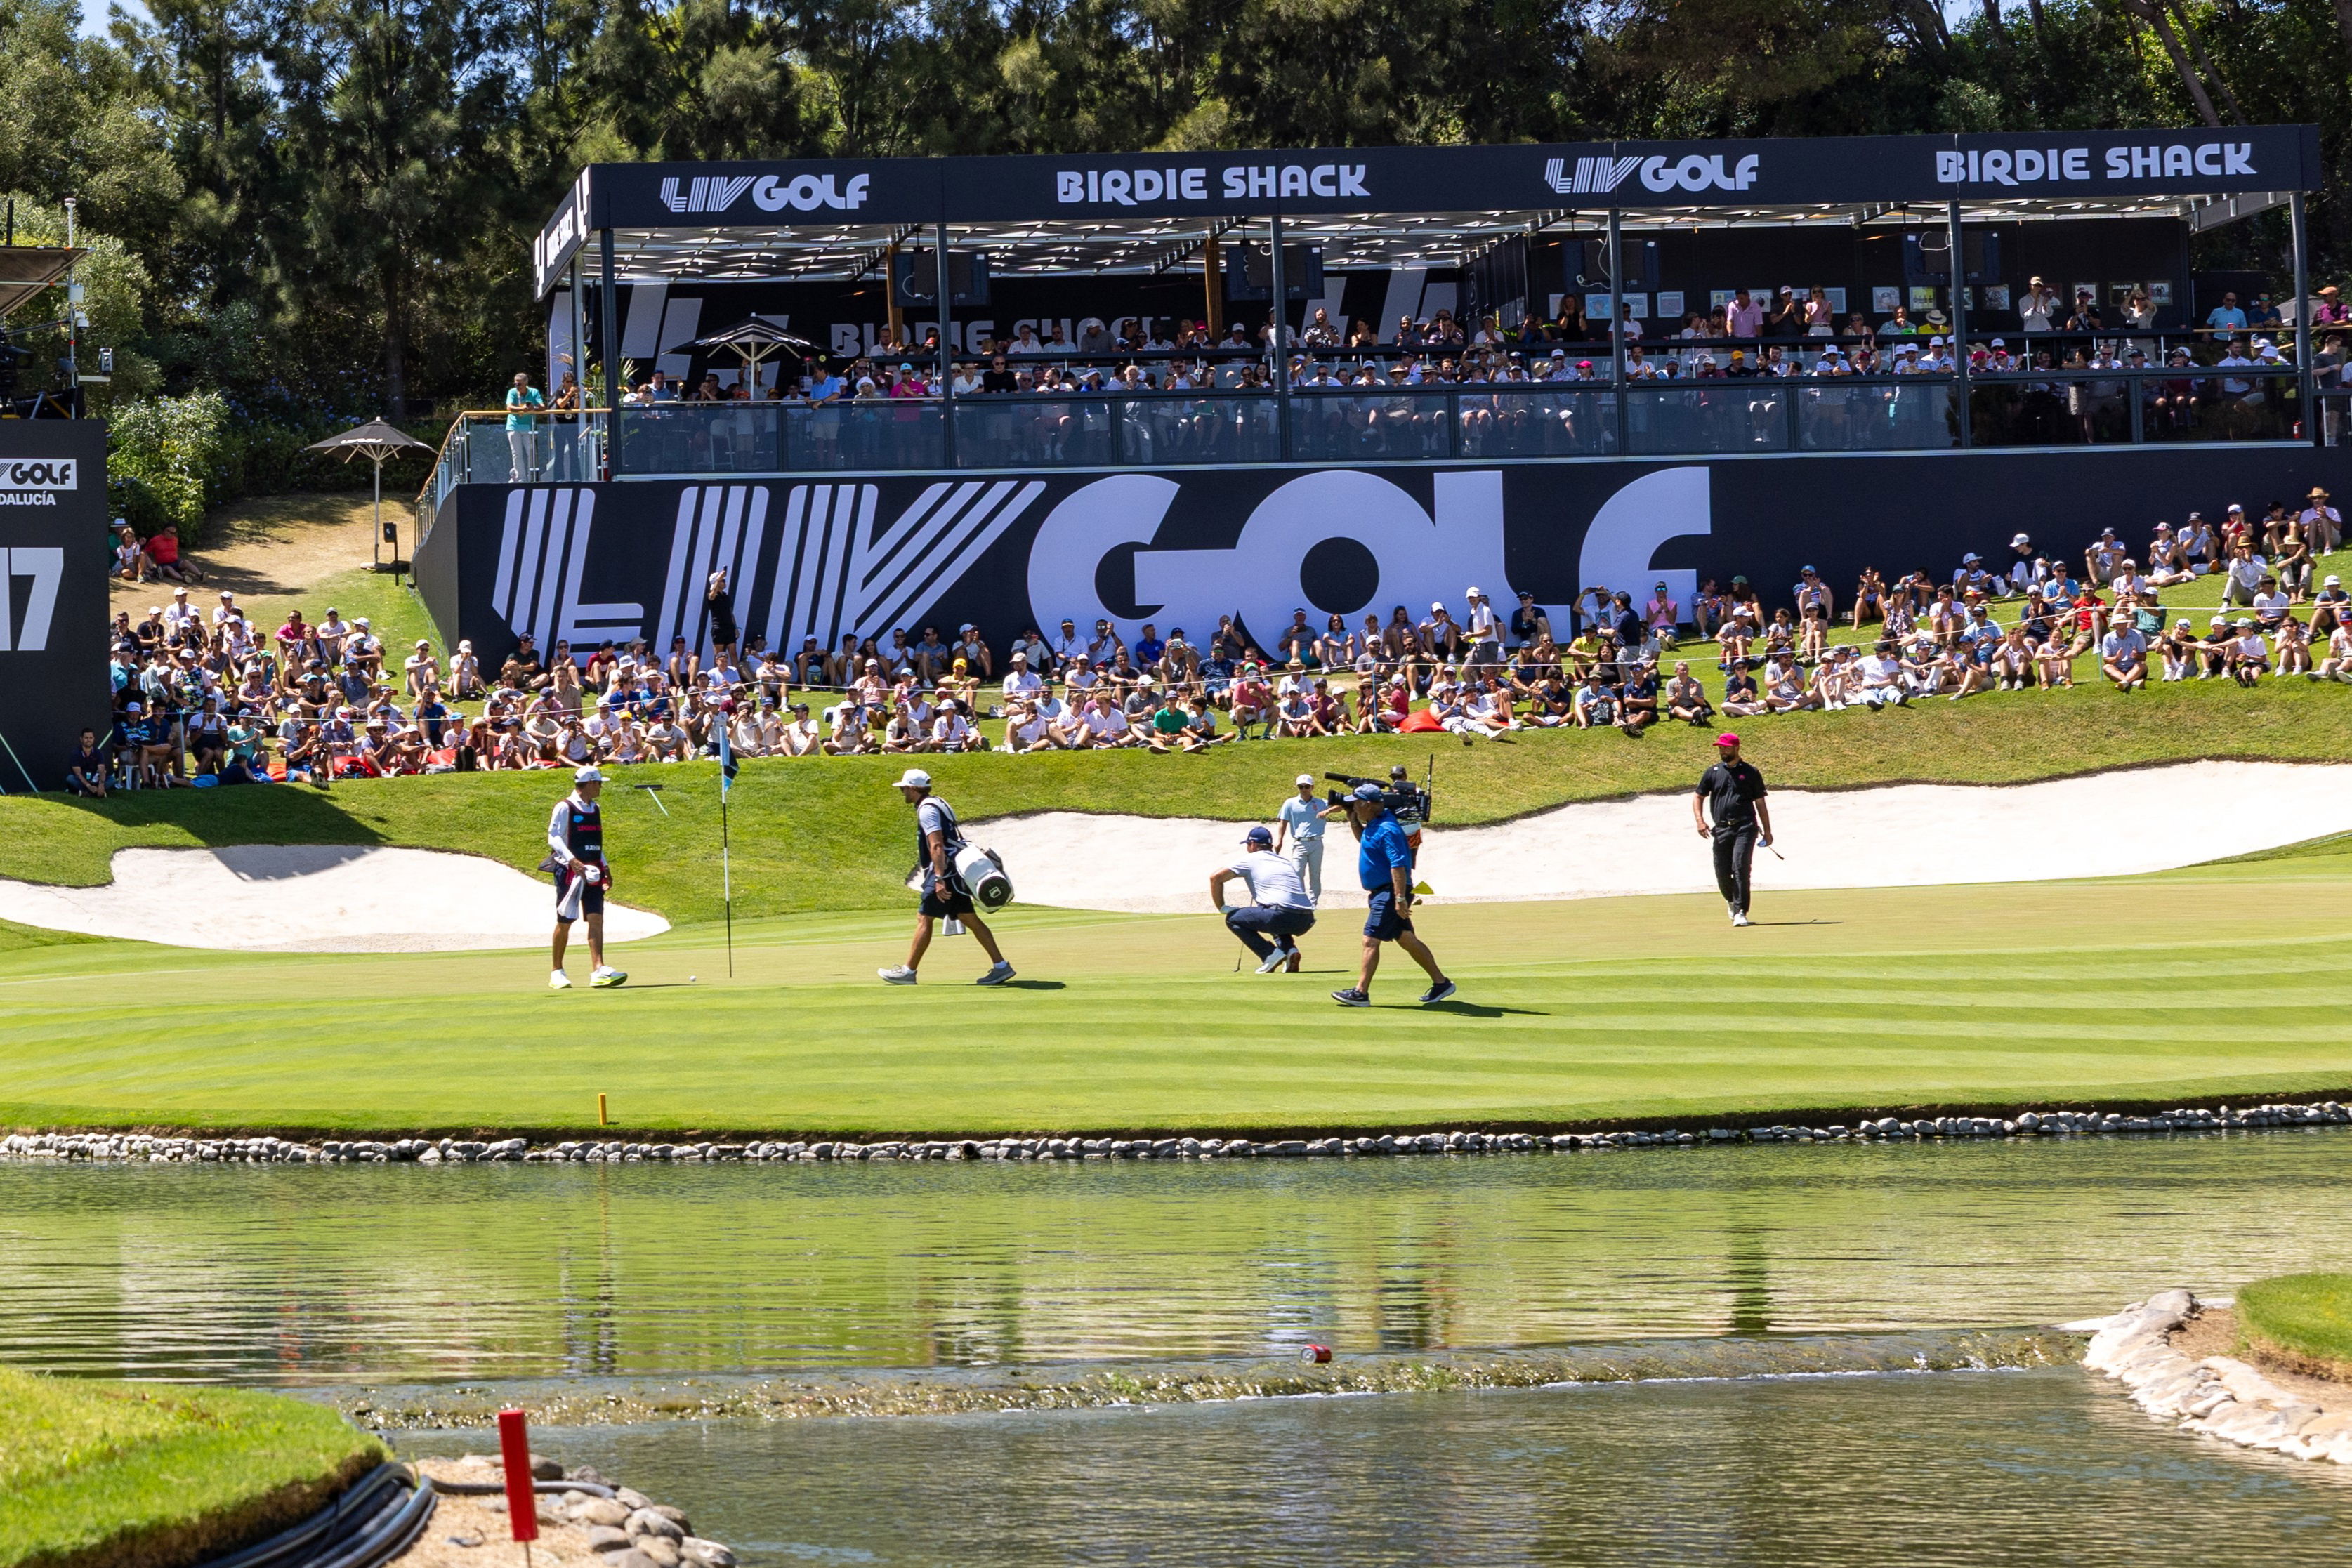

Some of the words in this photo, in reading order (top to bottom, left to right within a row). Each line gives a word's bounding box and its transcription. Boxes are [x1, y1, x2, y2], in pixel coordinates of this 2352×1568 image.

[1544, 157, 1644, 194] LIV
[1640, 154, 1759, 192] GOLF
[1936, 148, 2091, 185] BIRDIE
[2105, 143, 2258, 178] SHACK
[660, 176, 757, 212] LIV
[752, 173, 870, 212] GOLF
[1057, 168, 1208, 206] BIRDIE
[1222, 165, 1371, 198] SHACK
[10, 462, 72, 485] GOLF
[492, 481, 1046, 668] LIV
[1027, 466, 1712, 666] GOLF
